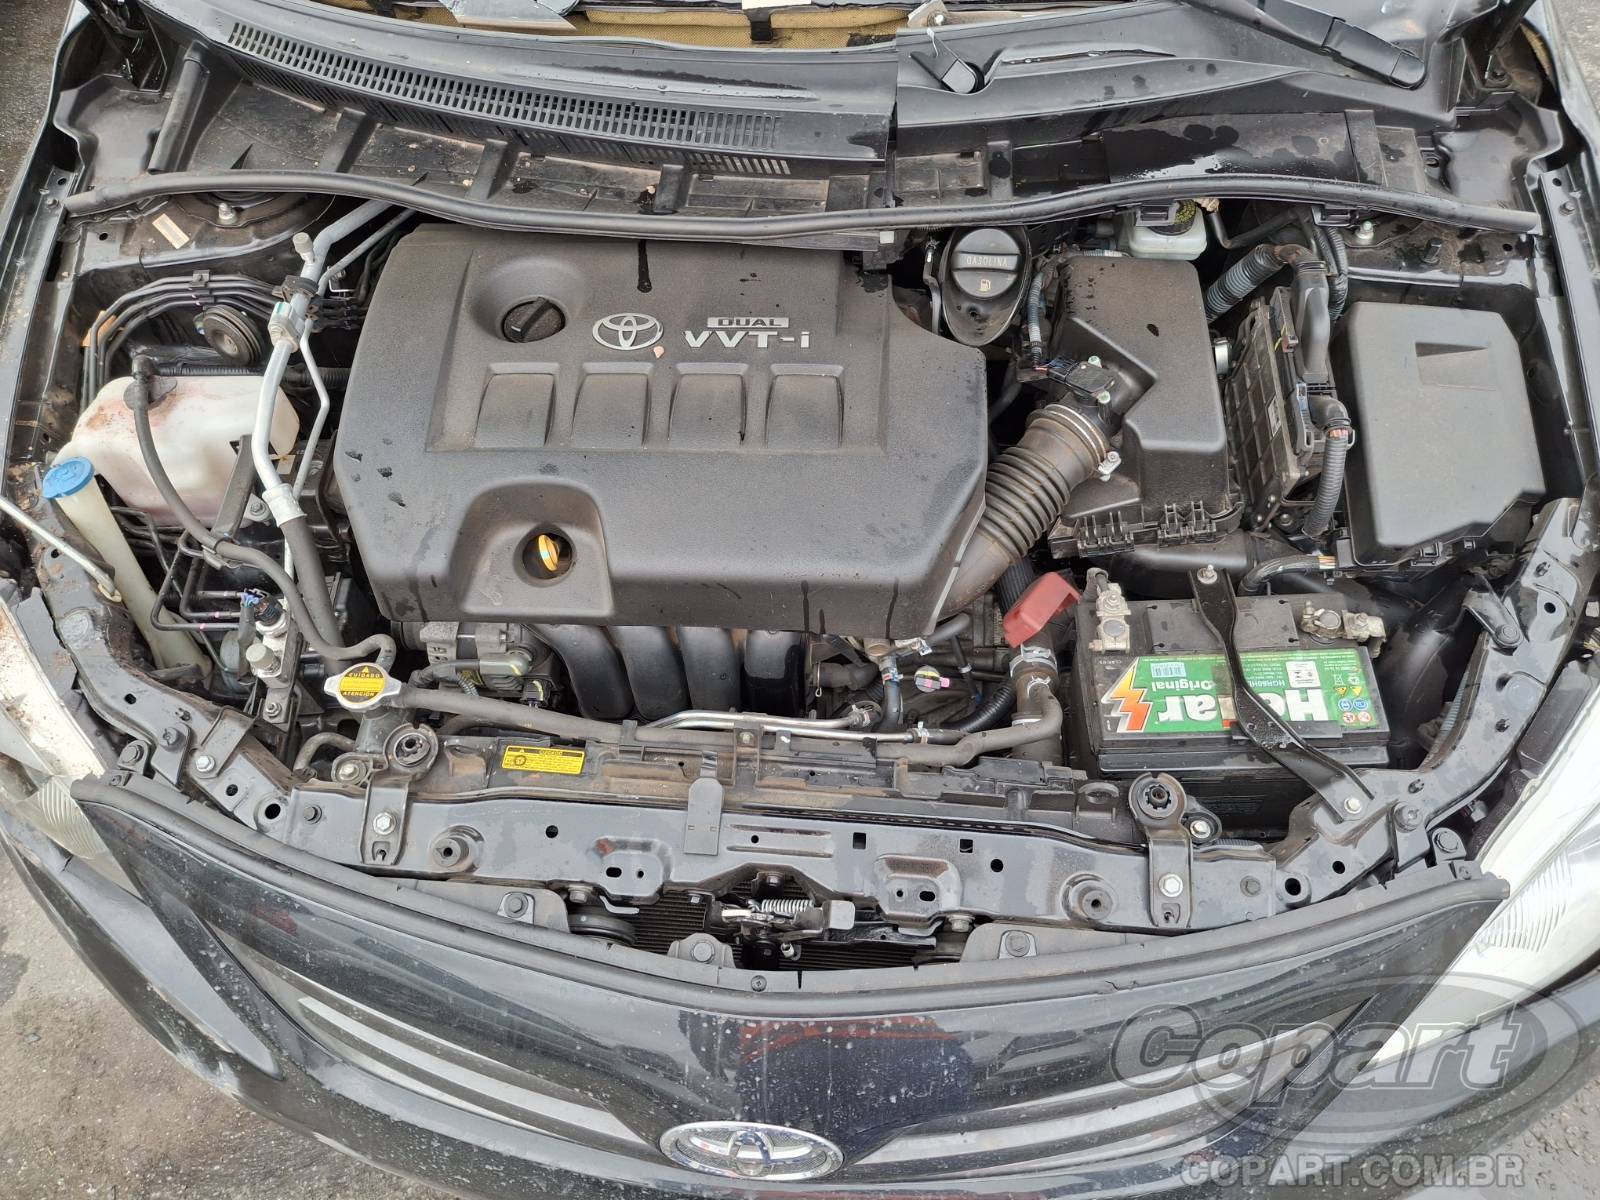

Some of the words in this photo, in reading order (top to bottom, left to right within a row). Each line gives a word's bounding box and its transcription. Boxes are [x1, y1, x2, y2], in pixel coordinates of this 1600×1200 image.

[966, 255, 1008, 267] GASOLINA
[717, 318, 783, 327] DUAL
[683, 330, 810, 348] VVT-i
[1151, 678, 1213, 692] Original
